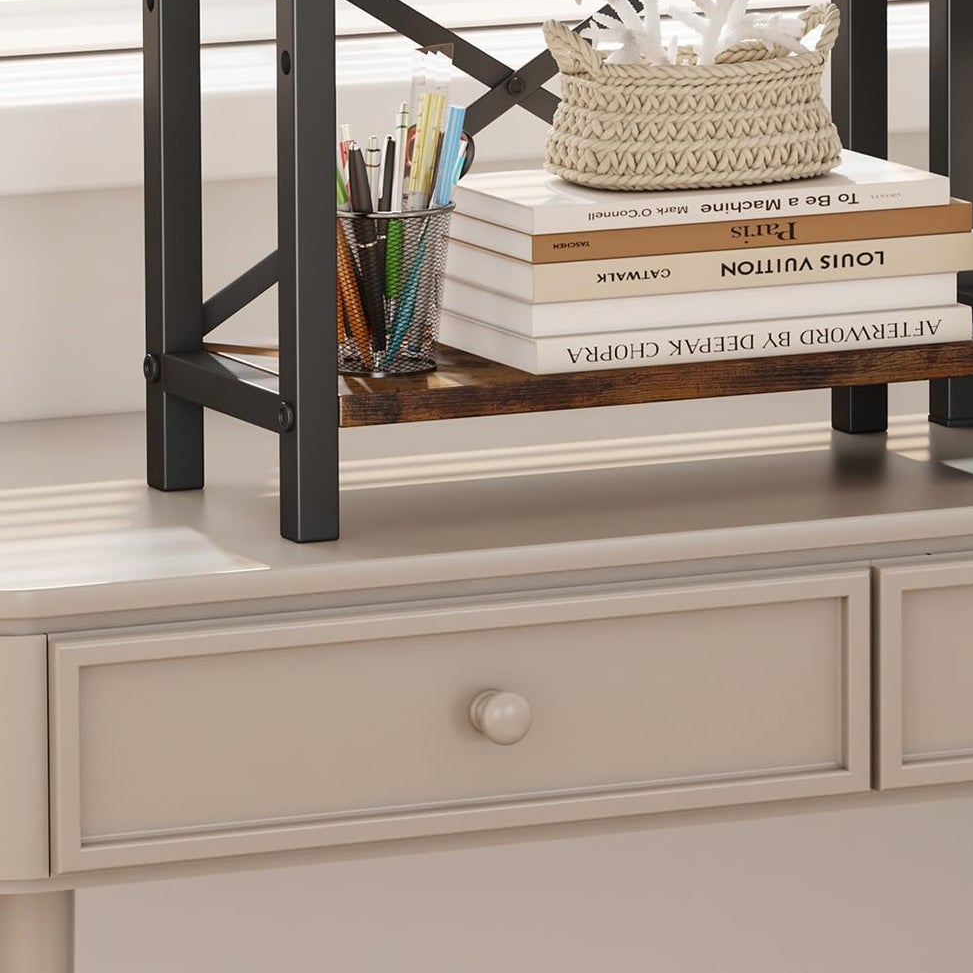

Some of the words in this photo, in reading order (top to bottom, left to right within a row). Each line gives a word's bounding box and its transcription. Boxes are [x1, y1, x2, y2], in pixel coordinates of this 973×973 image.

[700, 198, 781, 214] Machine
[788, 197, 799, 206] a
[805, 194, 831, 207] Be
[838, 192, 860, 205] To
[588, 208, 653, 221] O'Connell
[656, 205, 689, 215] Mark
[730, 221, 798, 244] Paris
[553, 240, 590, 250] TASCHEN
[720, 256, 813, 277] VUITTON
[819, 250, 885, 269] LOUIS
[596, 268, 671, 283] CATWALK
[761, 331, 791, 349] BY
[799, 319, 942, 346] AFTERWORD
[566, 341, 660, 364] CHOPRA
[668, 334, 755, 357] DEEPAK
